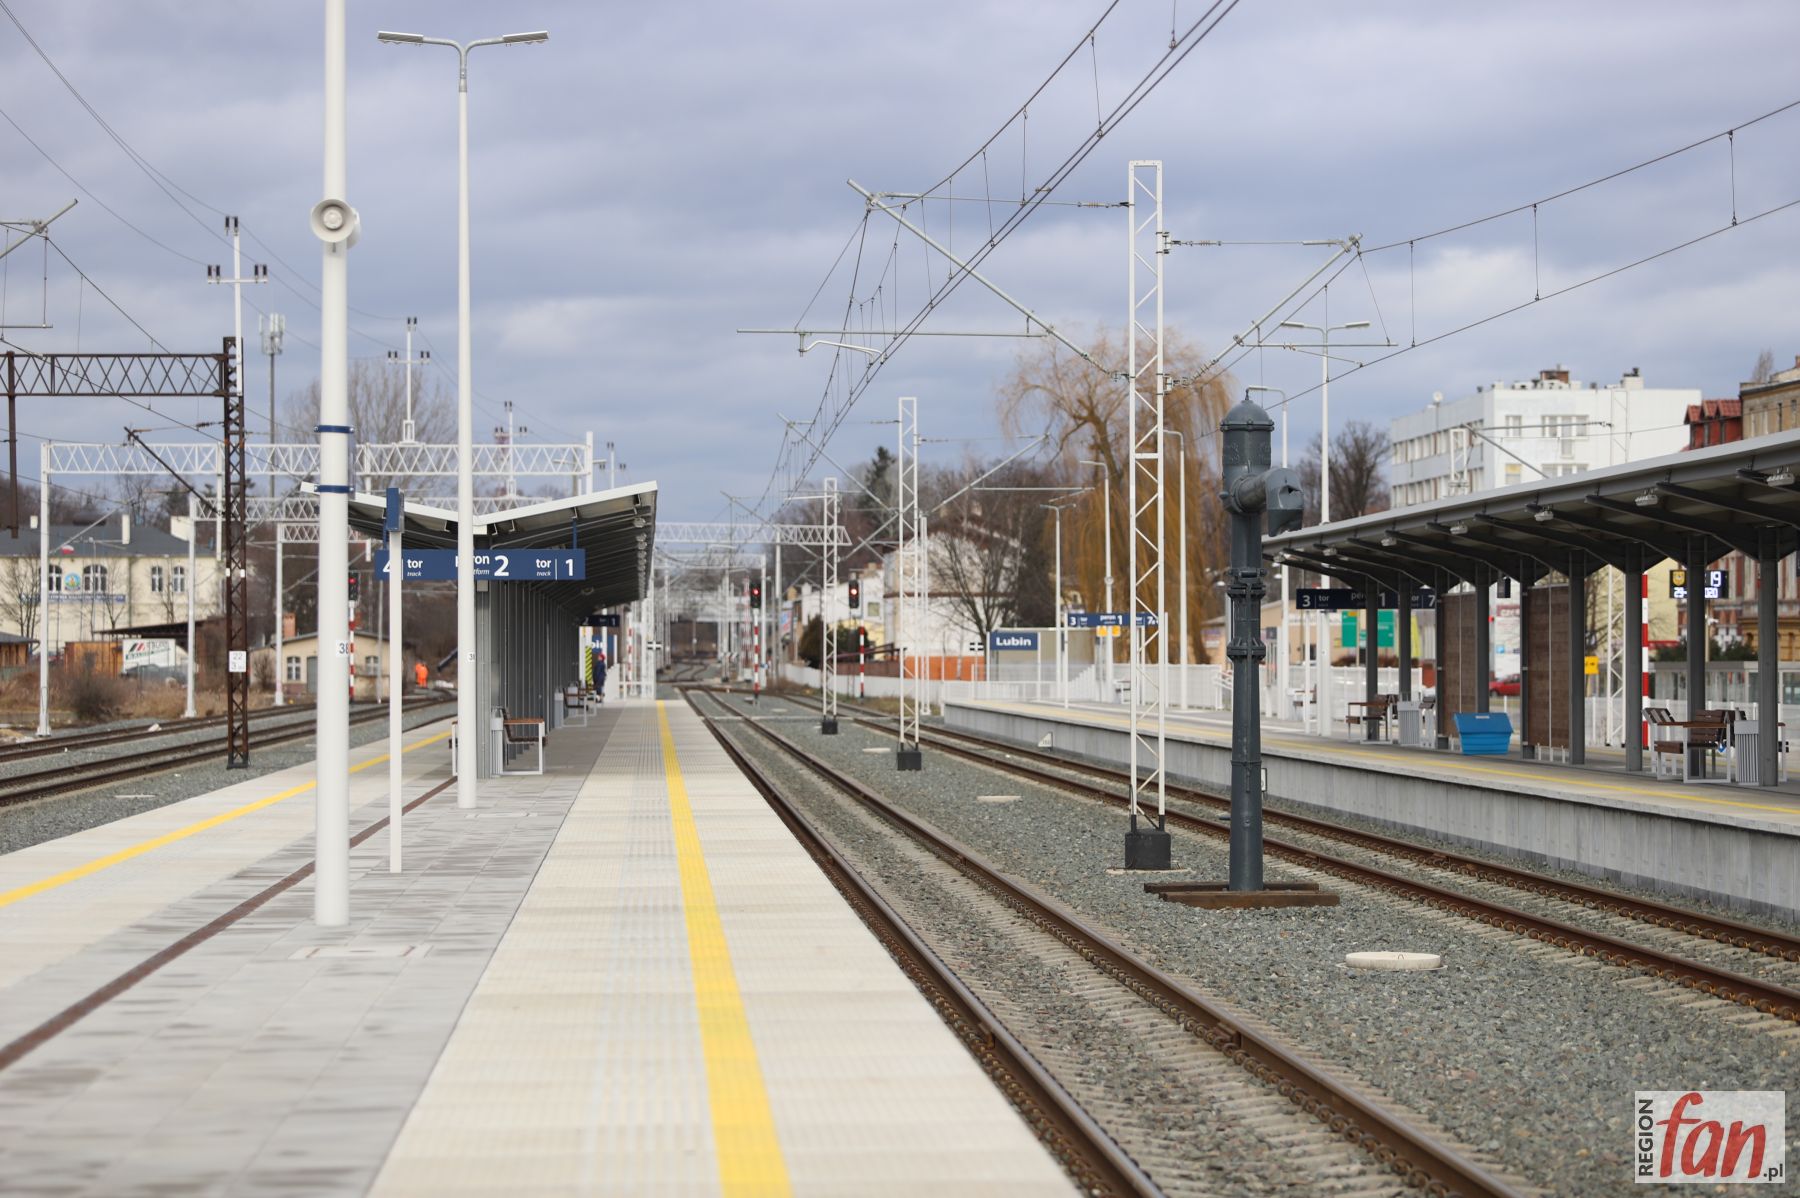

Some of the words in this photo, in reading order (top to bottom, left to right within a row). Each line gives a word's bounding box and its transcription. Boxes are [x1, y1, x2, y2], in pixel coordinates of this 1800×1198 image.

[407, 559, 424, 569] tor
[494, 555, 509, 576] 2
[536, 559, 551, 568] tor
[565, 559, 573, 576] 1
[1302, 595, 1311, 607] 3
[1379, 593, 1386, 606] 1
[1428, 594, 1436, 607] 7
[1070, 617, 1077, 626] 3
[1117, 615, 1123, 625] 1
[995, 636, 1032, 647] Lubin
